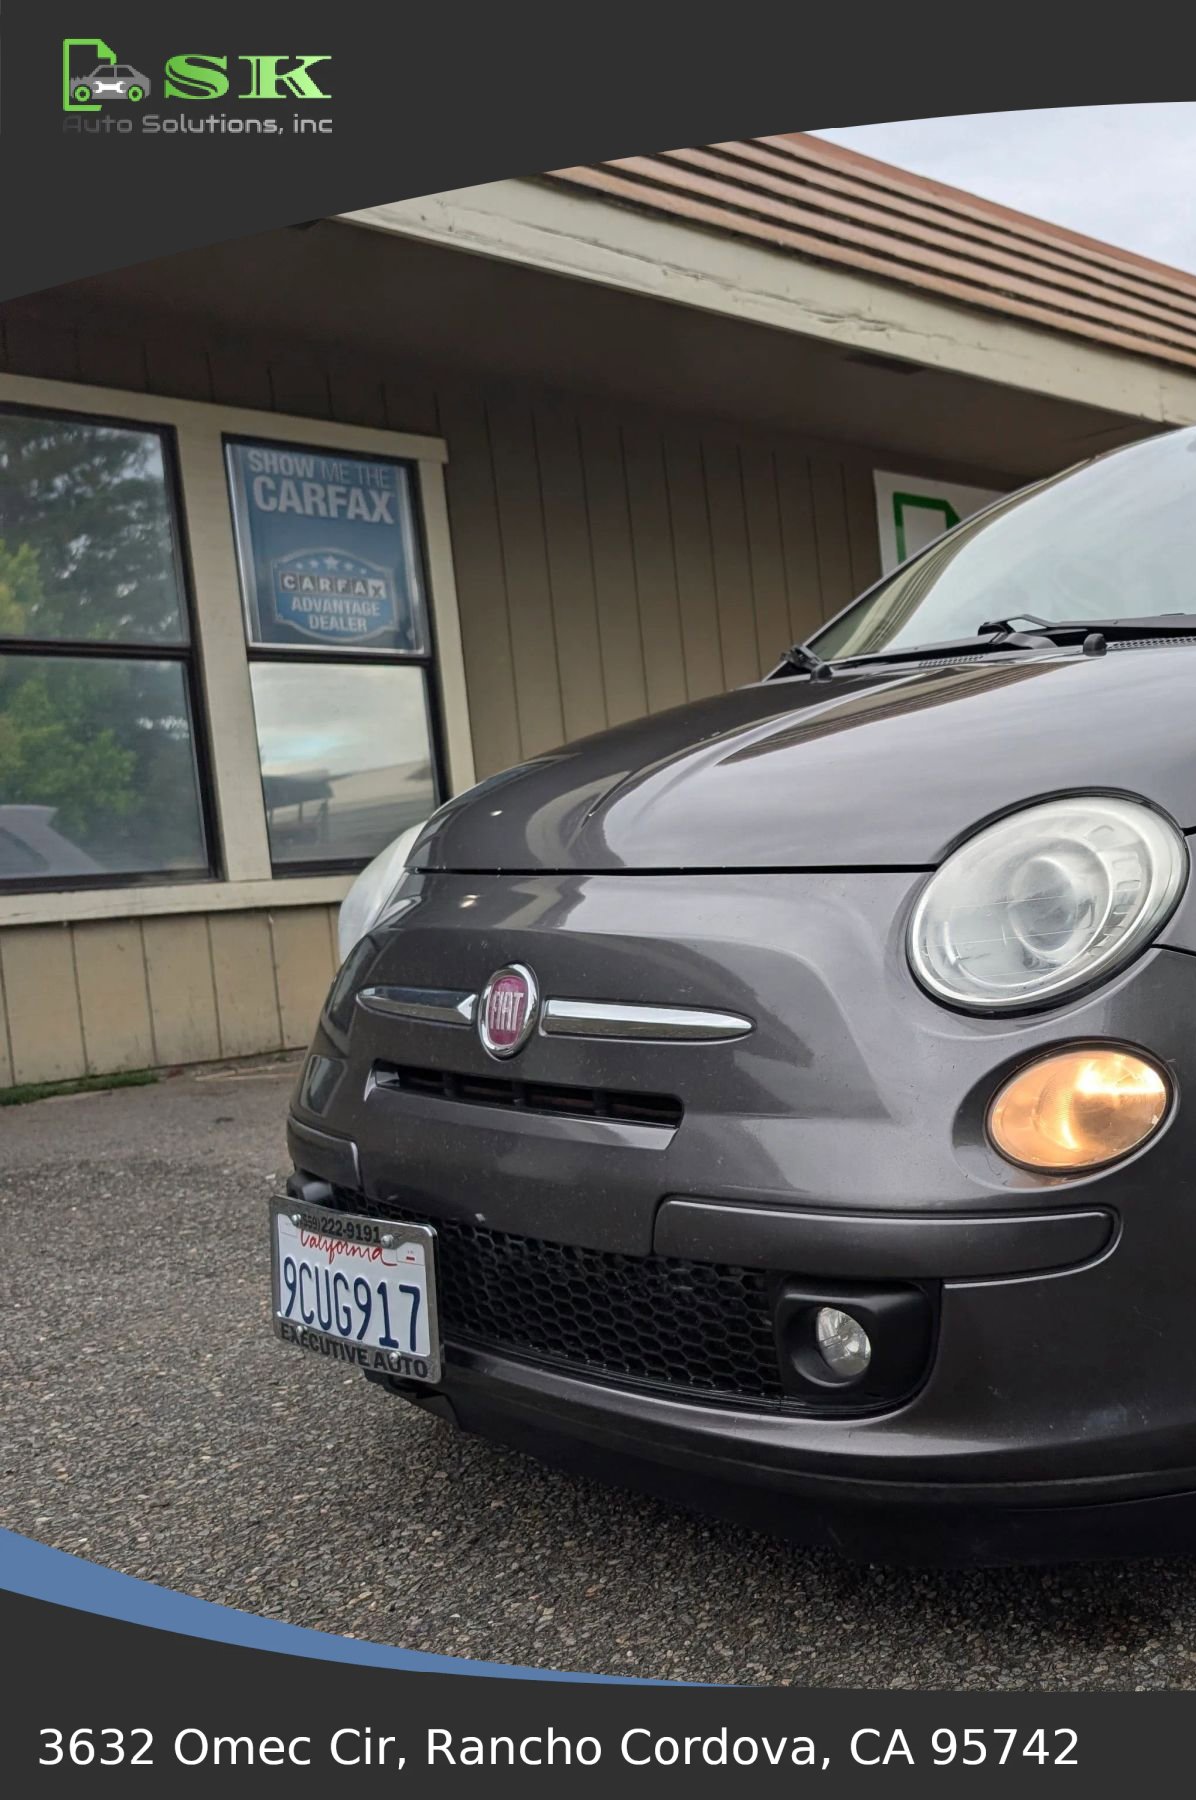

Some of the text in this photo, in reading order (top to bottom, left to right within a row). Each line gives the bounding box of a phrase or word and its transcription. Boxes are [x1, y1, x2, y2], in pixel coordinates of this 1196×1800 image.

[248, 450, 391, 489] SHOW ME THE
[252, 475, 395, 525] CARFAX
[280, 574, 387, 600] CARFAX
[291, 596, 381, 617] ADVANTAGE
[308, 614, 368, 633] DEALER
[490, 991, 525, 1031] FIAT
[300, 1229, 398, 1266] California
[283, 1256, 421, 1352] 9CUG917
[281, 1322, 428, 1379] EXECUTIVE AUTO
